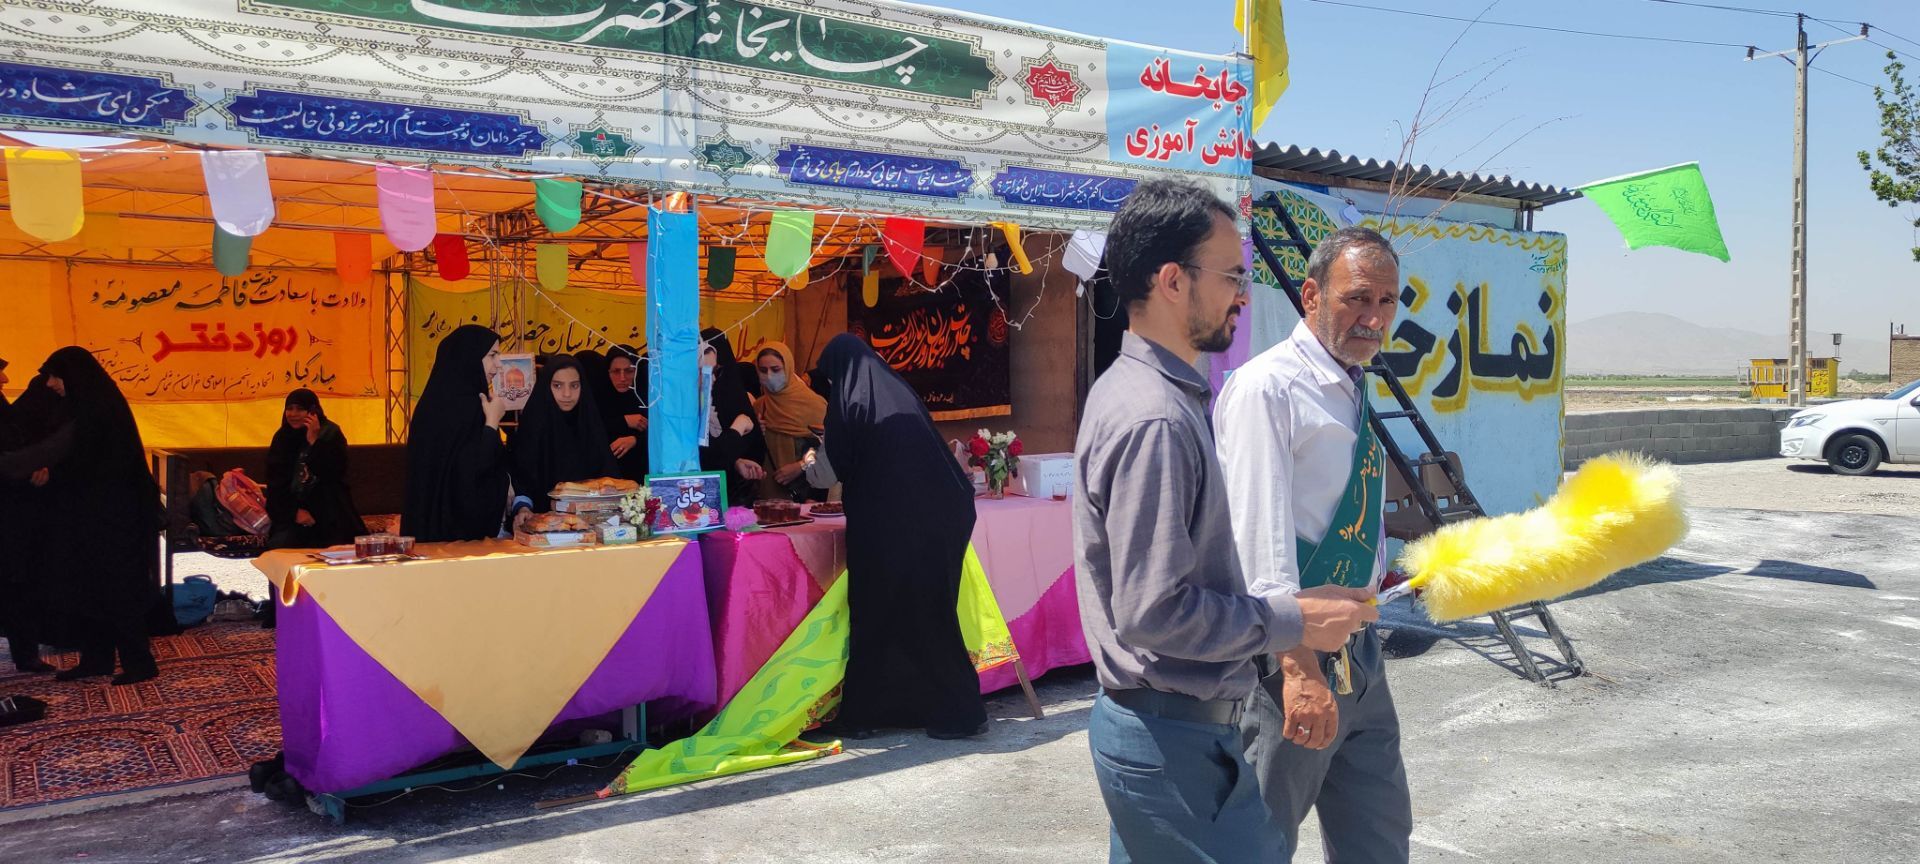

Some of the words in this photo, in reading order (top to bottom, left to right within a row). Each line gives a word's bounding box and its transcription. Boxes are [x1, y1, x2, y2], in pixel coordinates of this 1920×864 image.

[21, 77, 112, 102] شاه
[1140, 57, 1247, 115] چایخانه
[121, 90, 172, 123] مکن
[1127, 119, 1198, 160] آموزی
[1202, 128, 1253, 165] دانش
[103, 278, 182, 312] معصومه
[175, 275, 248, 312] فاطمه
[249, 278, 309, 307] سعادت
[321, 290, 366, 308] ولادت
[254, 322, 298, 360] روز
